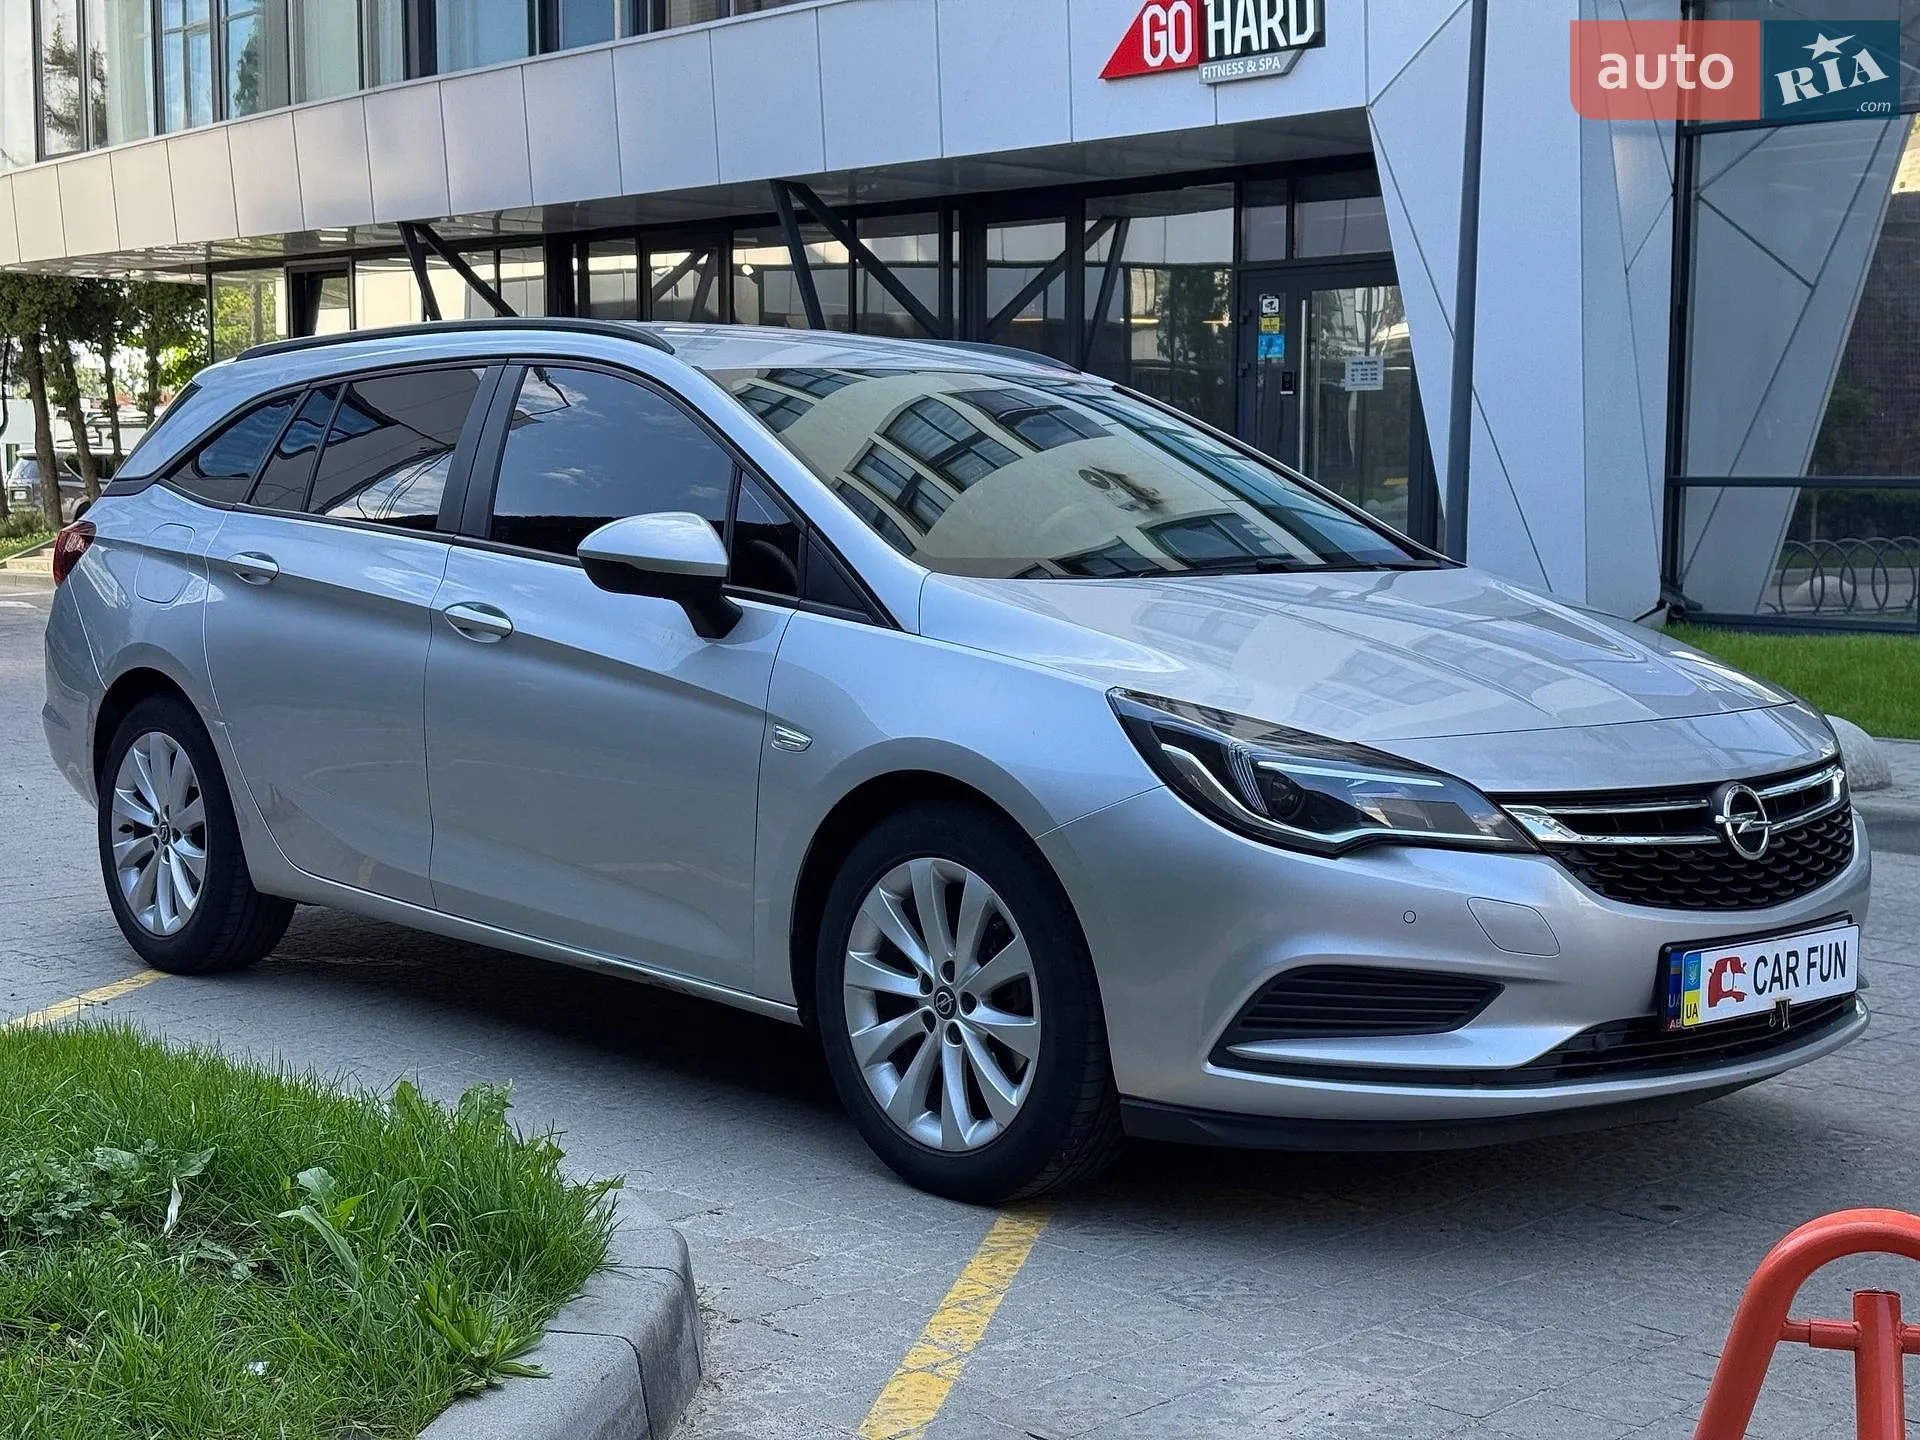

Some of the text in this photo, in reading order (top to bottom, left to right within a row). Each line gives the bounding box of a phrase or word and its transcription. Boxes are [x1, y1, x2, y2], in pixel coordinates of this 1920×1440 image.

[1142, 0, 1315, 67] GO HARD
[1202, 56, 1281, 79] FITNESS & SPA
[1753, 940, 1847, 996] CAR FUN
[1686, 1002, 1698, 1019] UA
